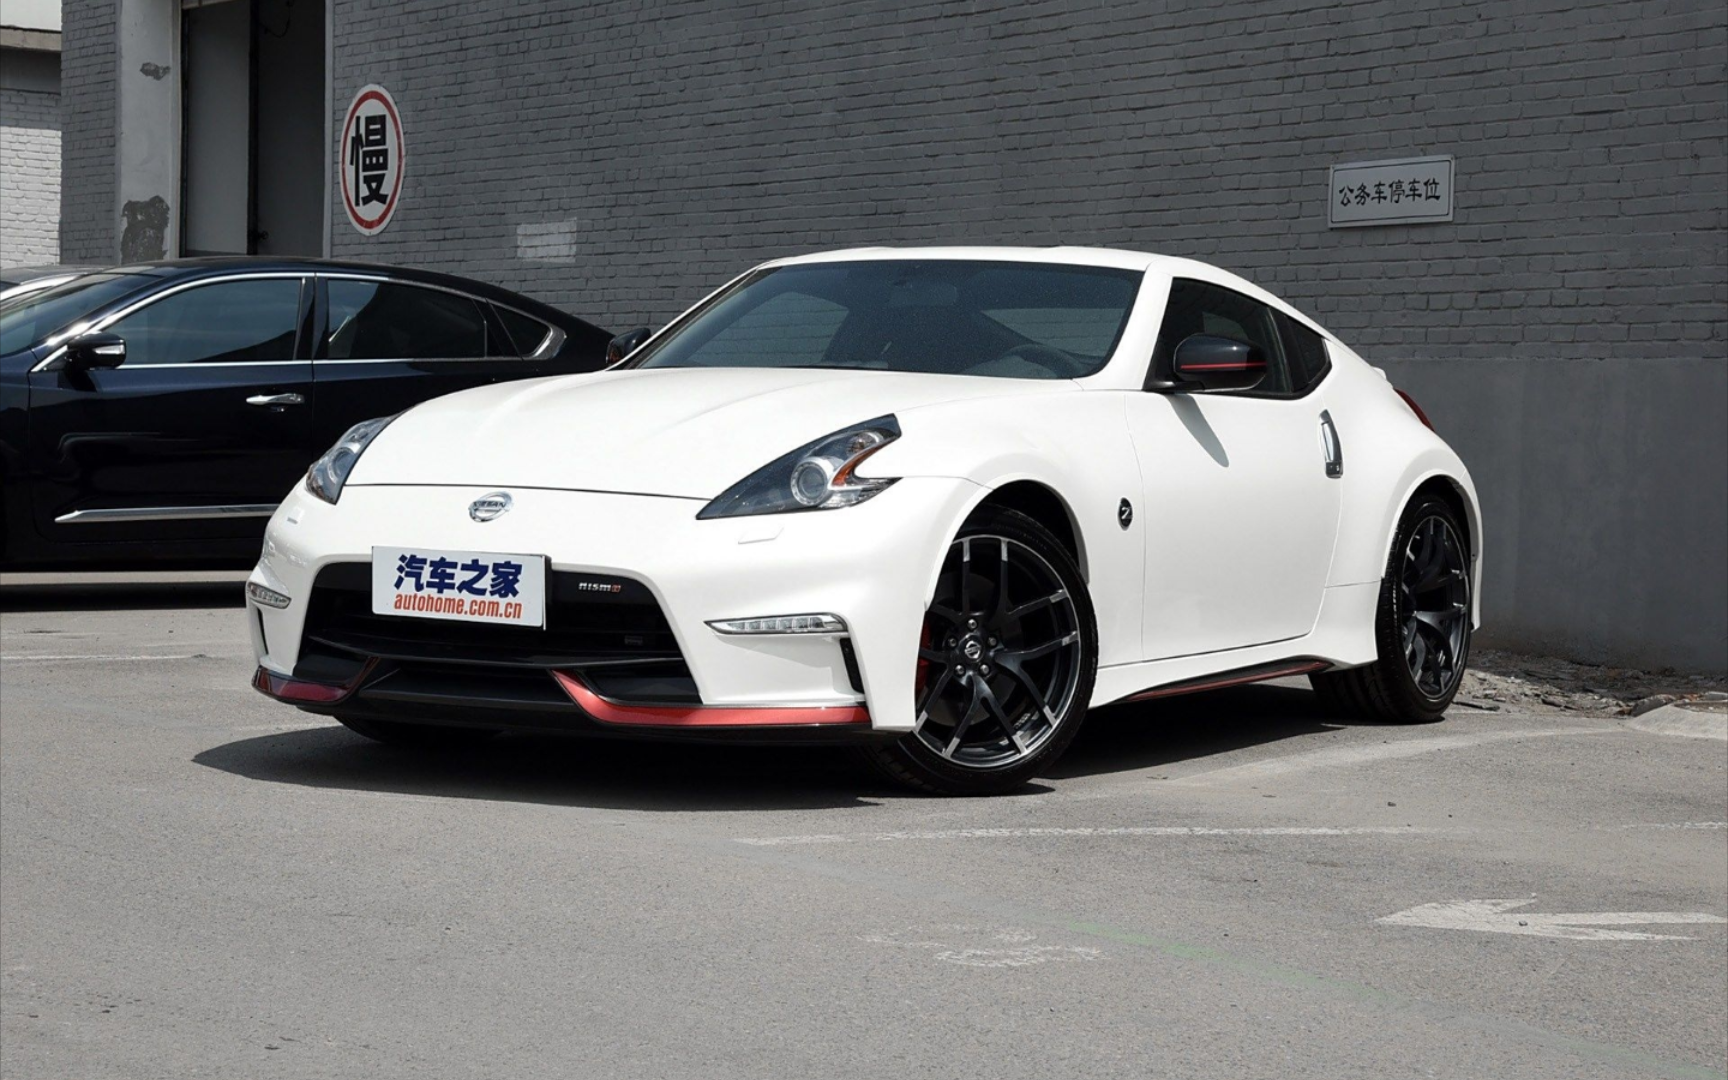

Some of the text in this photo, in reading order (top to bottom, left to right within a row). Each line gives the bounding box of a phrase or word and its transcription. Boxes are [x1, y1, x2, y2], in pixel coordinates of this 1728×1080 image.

[350, 114, 389, 207] 慢
[1339, 178, 1441, 207] 公务车停车位
[394, 554, 523, 598] 汽车之家
[394, 593, 522, 619] autohome.com.cn
